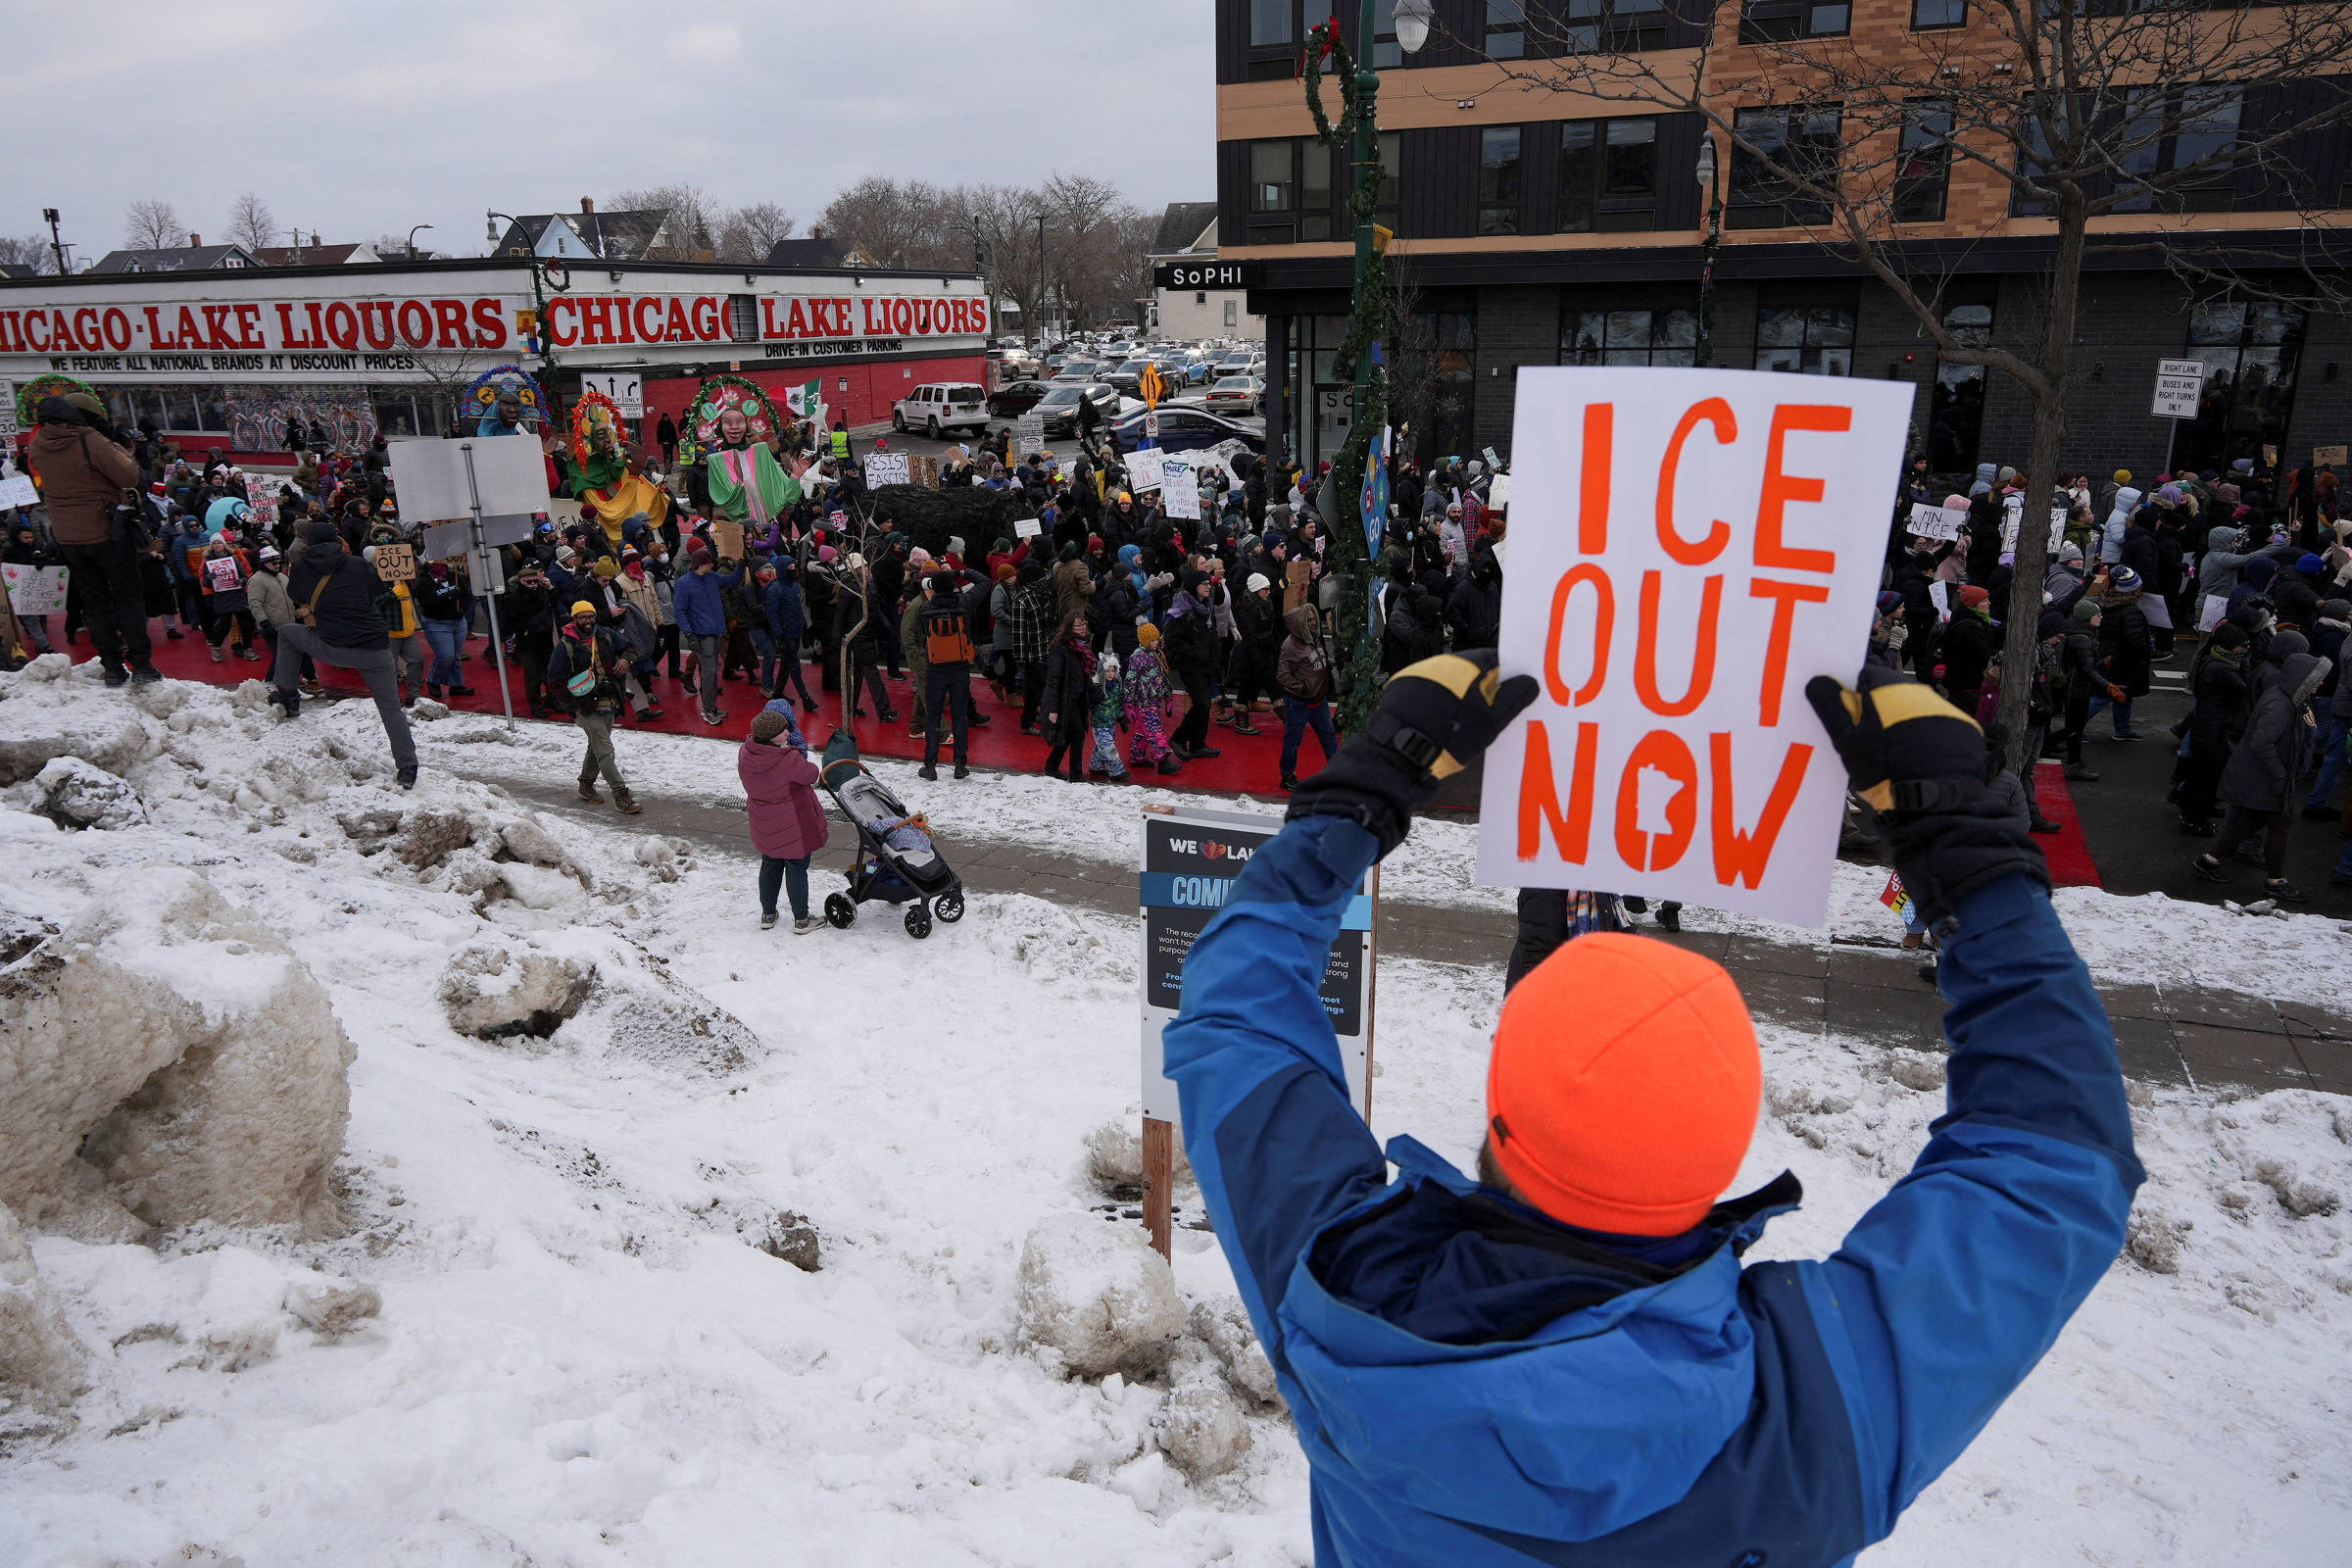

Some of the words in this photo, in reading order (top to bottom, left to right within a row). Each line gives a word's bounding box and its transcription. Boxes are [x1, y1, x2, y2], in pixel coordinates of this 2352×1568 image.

[1174, 267, 1241, 285] SoPHI
[143, 303, 266, 351] LAKE
[275, 298, 508, 350] LIQUORS
[760, 298, 854, 339] LAKE
[862, 297, 987, 336] LIQUORS
[765, 343, 809, 358] DRIVE-IN
[813, 340, 863, 355] CUSTOMER
[867, 339, 903, 353] PARKING
[49, 357, 69, 370] WE
[72, 357, 122, 370] FEATURE
[126, 356, 147, 370] ALL
[150, 356, 209, 370] NATIONAL
[212, 355, 264, 370] BRANDS
[270, 355, 284, 369] AT
[290, 355, 358, 369] DISCOUNT
[364, 355, 415, 369] PRICES
[2164, 364, 2181, 372] RIGHT
[2162, 379, 2181, 388] BUSES
[2158, 391, 2176, 400] RIGHT
[2177, 392, 2196, 401] TURNS
[2168, 403, 2182, 412] ONLY
[0, 423, 17, 433] 30
[864, 454, 907, 470] RESIST
[1579, 397, 1852, 573] ICE
[1921, 510, 1942, 524] MN
[2050, 510, 2067, 518] SAFE
[1369, 515, 1380, 542] GO
[1911, 519, 1950, 538] NICE
[380, 547, 402, 556] ICE
[377, 555, 412, 568] OUT
[385, 569, 414, 579] NOW
[22, 578, 48, 588] SPEAK
[1544, 563, 1830, 726] OUT
[1517, 719, 1814, 890] NOW
[1169, 838, 1198, 855] WE
[1172, 876, 1237, 906] COMI
[1165, 927, 1179, 936] The
[1181, 930, 1200, 939] reco
[1158, 936, 1180, 945] won't
[1318, 996, 1341, 1004] reet
